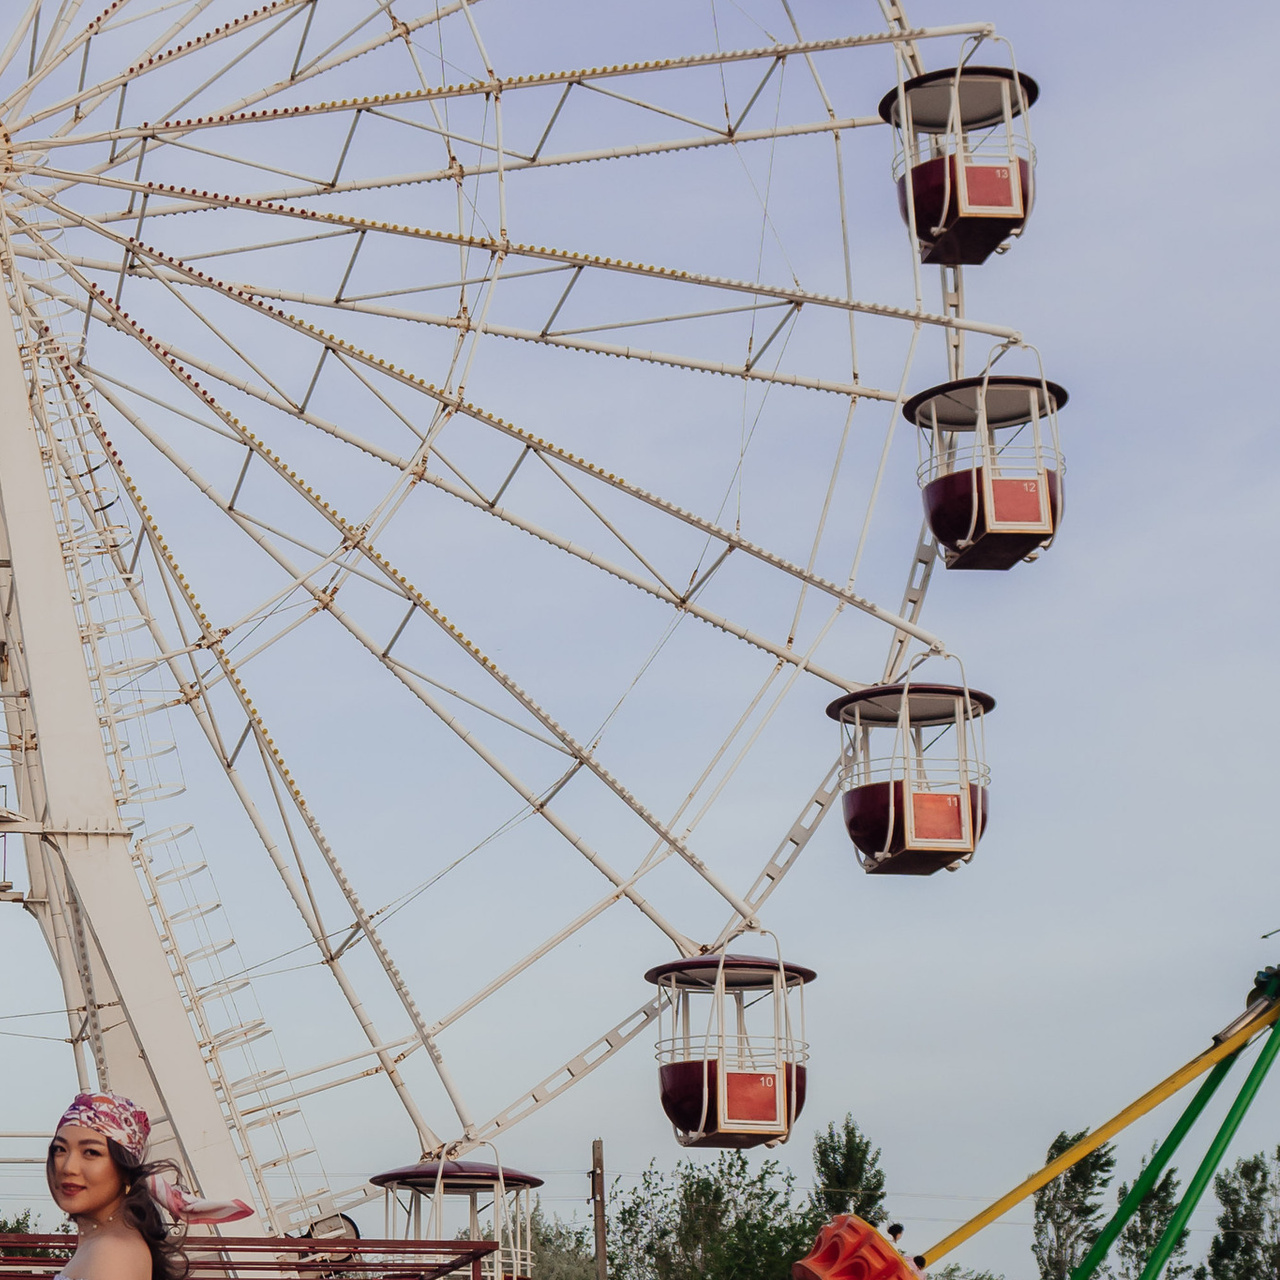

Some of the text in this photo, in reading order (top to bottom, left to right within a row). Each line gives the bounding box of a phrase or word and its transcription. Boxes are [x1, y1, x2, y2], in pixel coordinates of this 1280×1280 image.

[996, 169, 1009, 179] 13
[1023, 482, 1036, 492] 12
[947, 796, 958, 807] 11
[760, 1076, 773, 1087] 10
